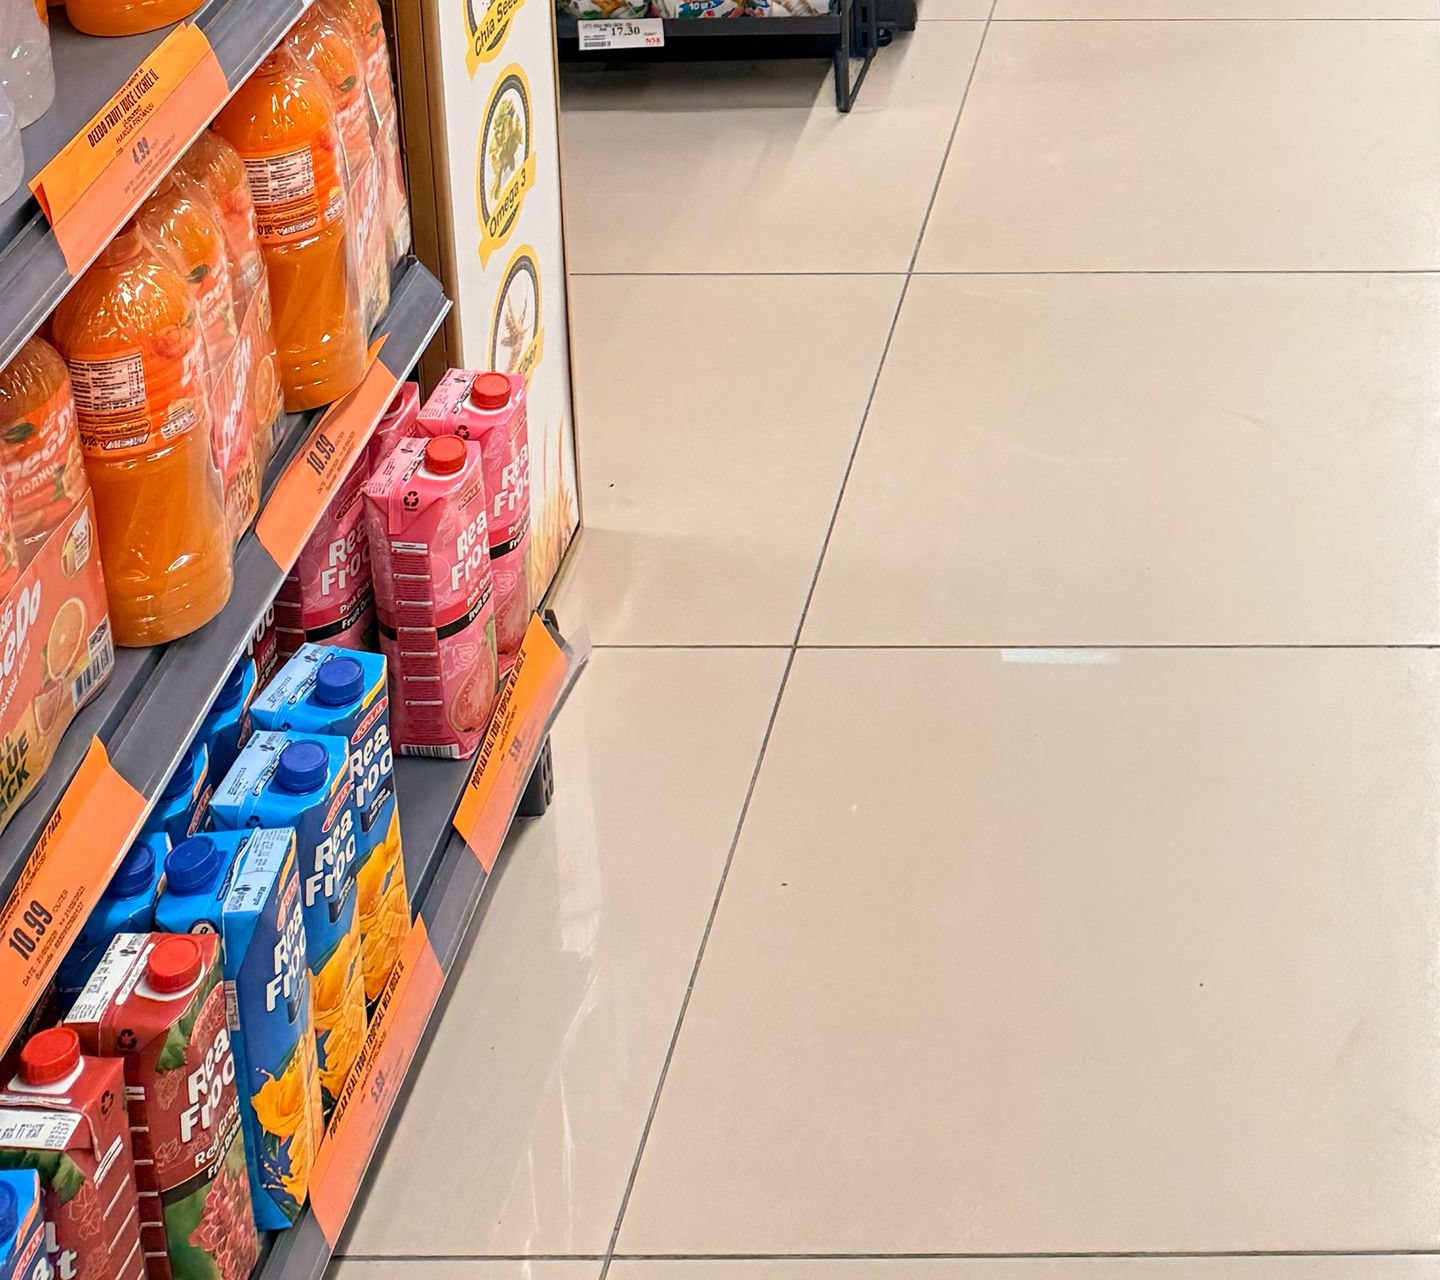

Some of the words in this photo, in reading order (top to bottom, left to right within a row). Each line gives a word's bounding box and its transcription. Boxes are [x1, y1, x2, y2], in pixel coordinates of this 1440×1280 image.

[474, 22, 496, 59] Chia
[610, 24, 641, 38] 17.30
[484, 195, 517, 241] Omega
[306, 433, 335, 477] 10.99
[8, 899, 53, 962] 10.99
[194, 1134, 219, 1169] Red
